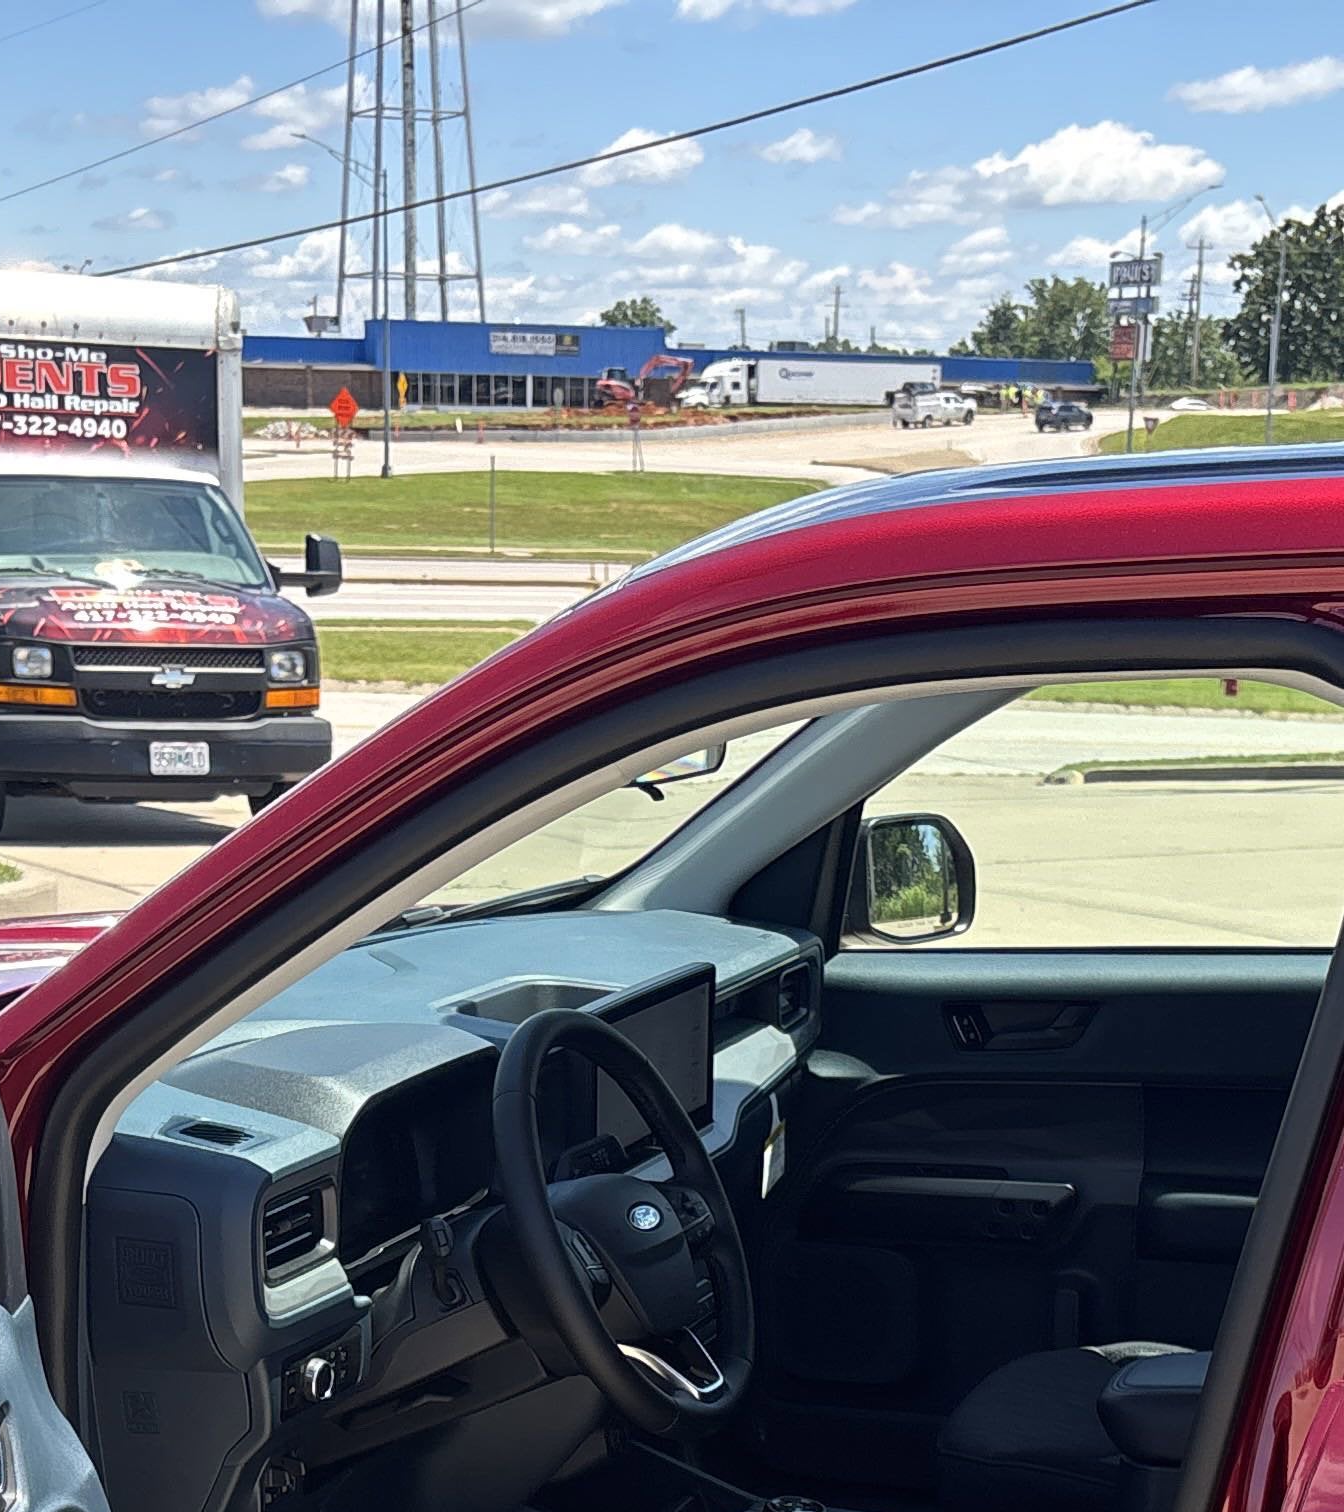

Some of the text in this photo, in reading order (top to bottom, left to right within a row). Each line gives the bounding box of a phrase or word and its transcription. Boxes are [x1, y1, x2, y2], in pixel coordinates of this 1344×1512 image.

[0, 343, 108, 363] Sho-Me
[13, 393, 59, 411] Hail
[64, 394, 140, 415] Repair
